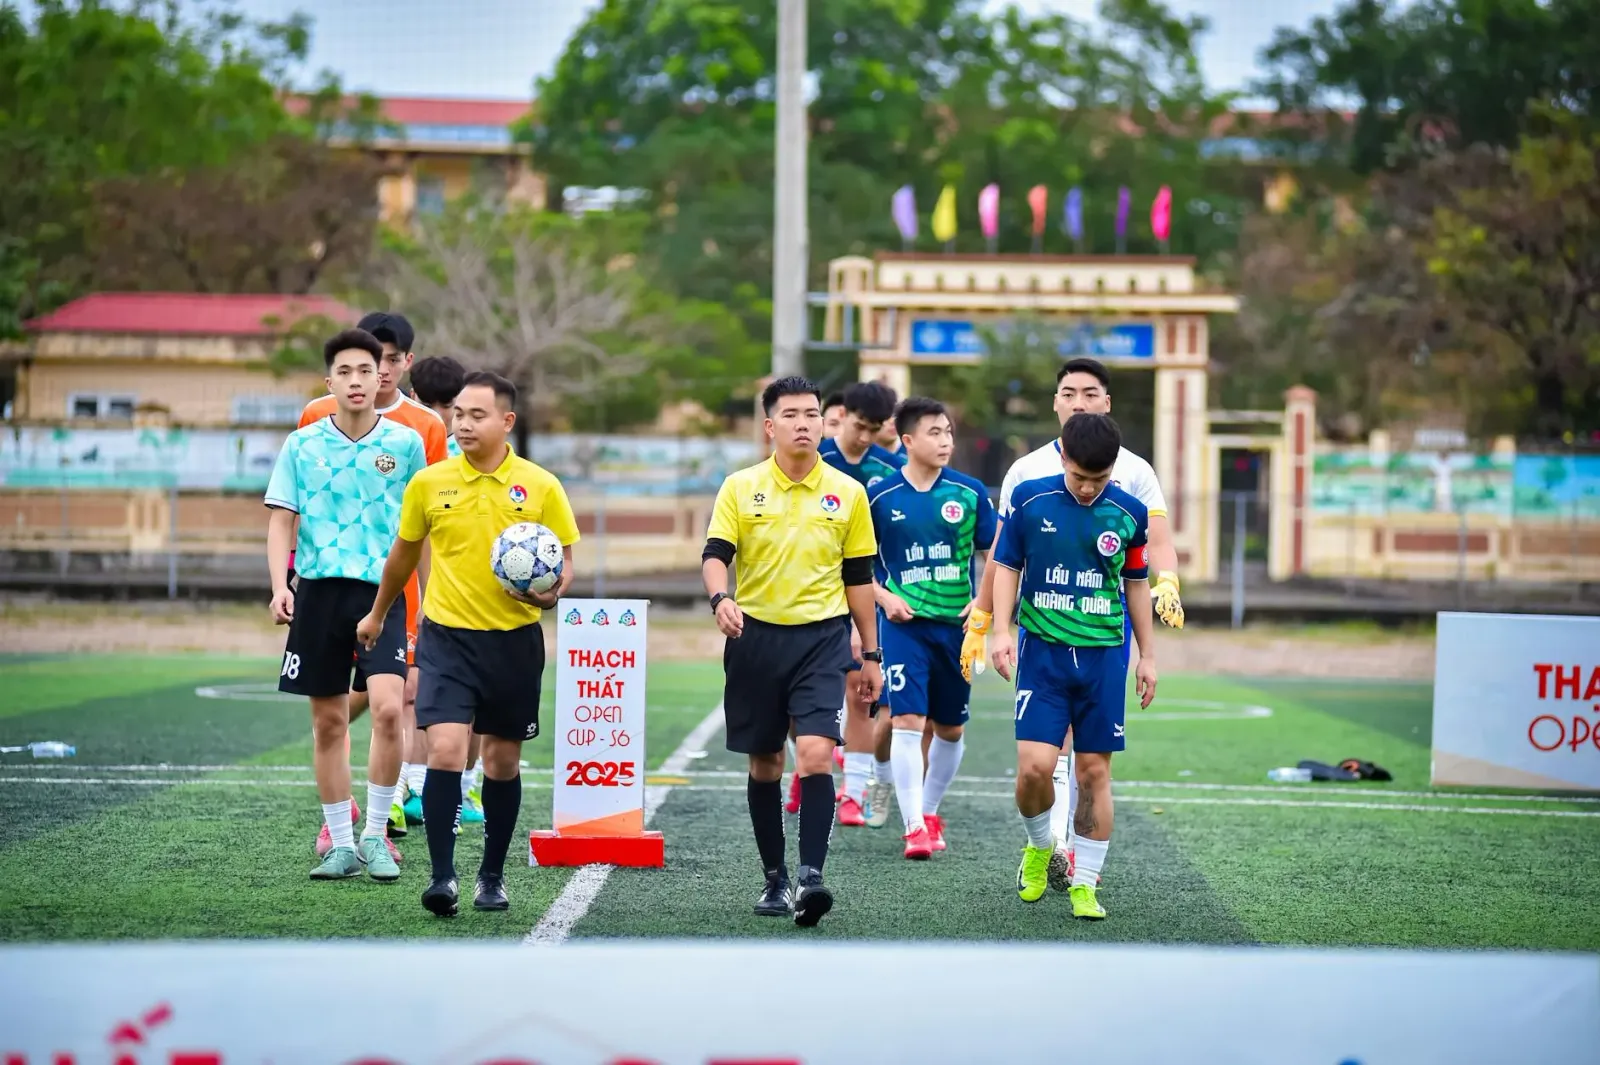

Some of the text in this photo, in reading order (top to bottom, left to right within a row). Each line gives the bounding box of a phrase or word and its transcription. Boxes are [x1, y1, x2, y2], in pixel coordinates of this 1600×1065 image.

[1045, 564, 1103, 588] LẨU NẤM
[1034, 590, 1111, 615] HOÀNG QUÂN
[281, 651, 300, 680] 18
[568, 649, 635, 672] THẠCH
[577, 673, 624, 698] THẤT
[886, 664, 906, 692] 13
[574, 705, 622, 723] OPEN
[567, 728, 596, 747] CUP
[610, 729, 630, 747] S6
[565, 761, 635, 787] 2025
